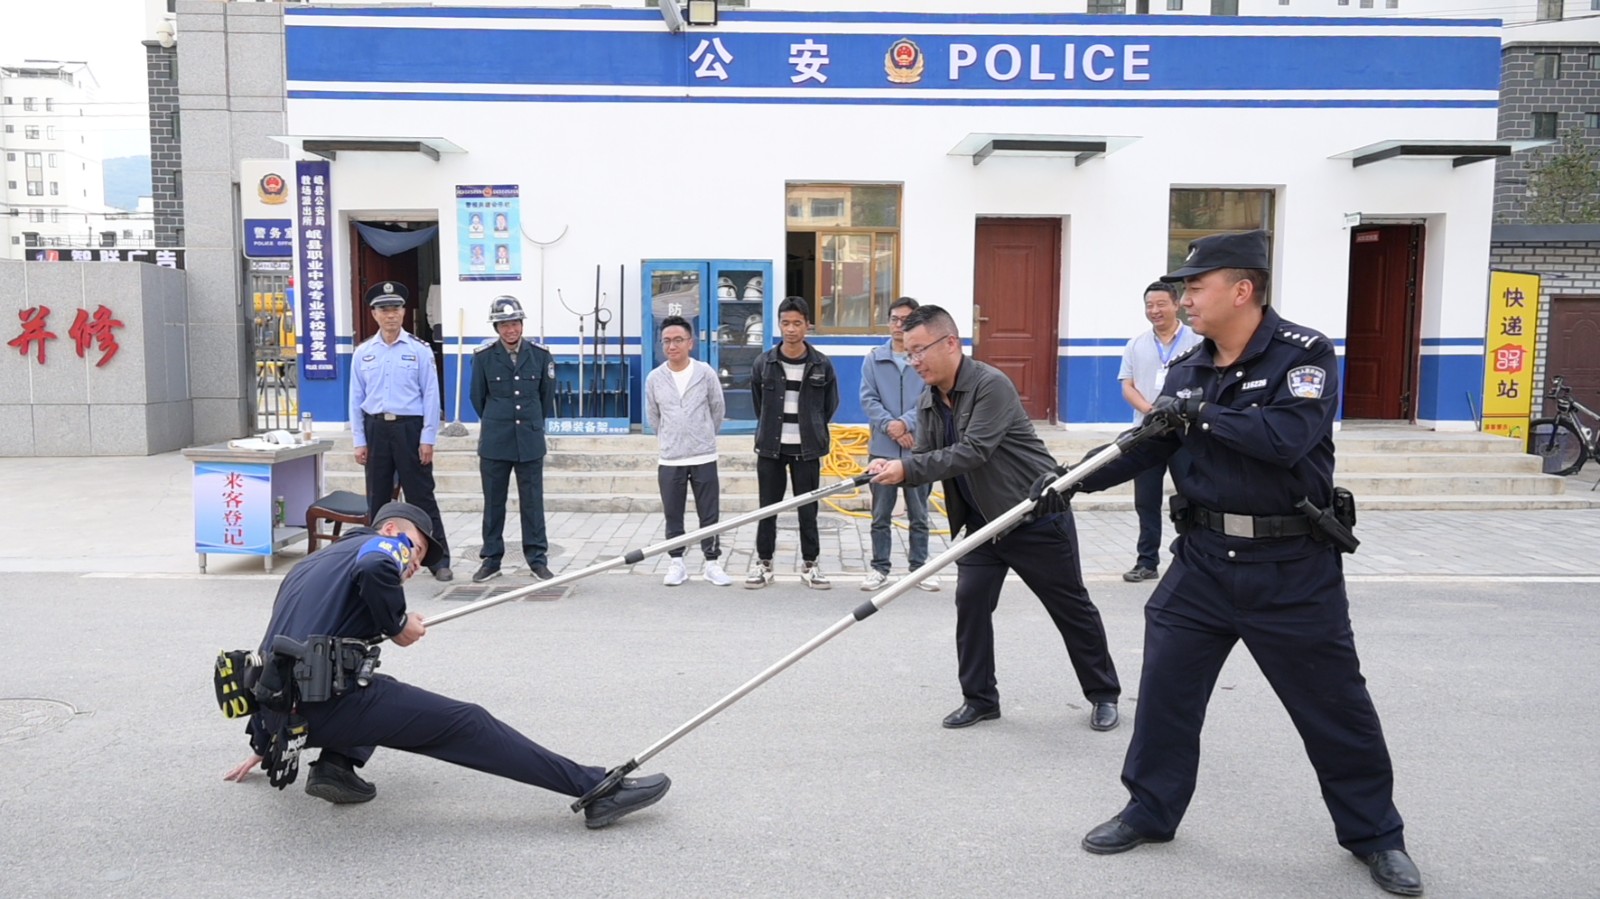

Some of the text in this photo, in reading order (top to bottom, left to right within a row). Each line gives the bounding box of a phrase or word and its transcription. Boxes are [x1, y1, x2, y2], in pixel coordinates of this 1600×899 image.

[689, 37, 830, 83] 公安
[949, 43, 1150, 81] POLICE
[668, 303, 682, 316] 防
[548, 420, 609, 433] 防爆装备架
[222, 472, 244, 546] 来客登记
